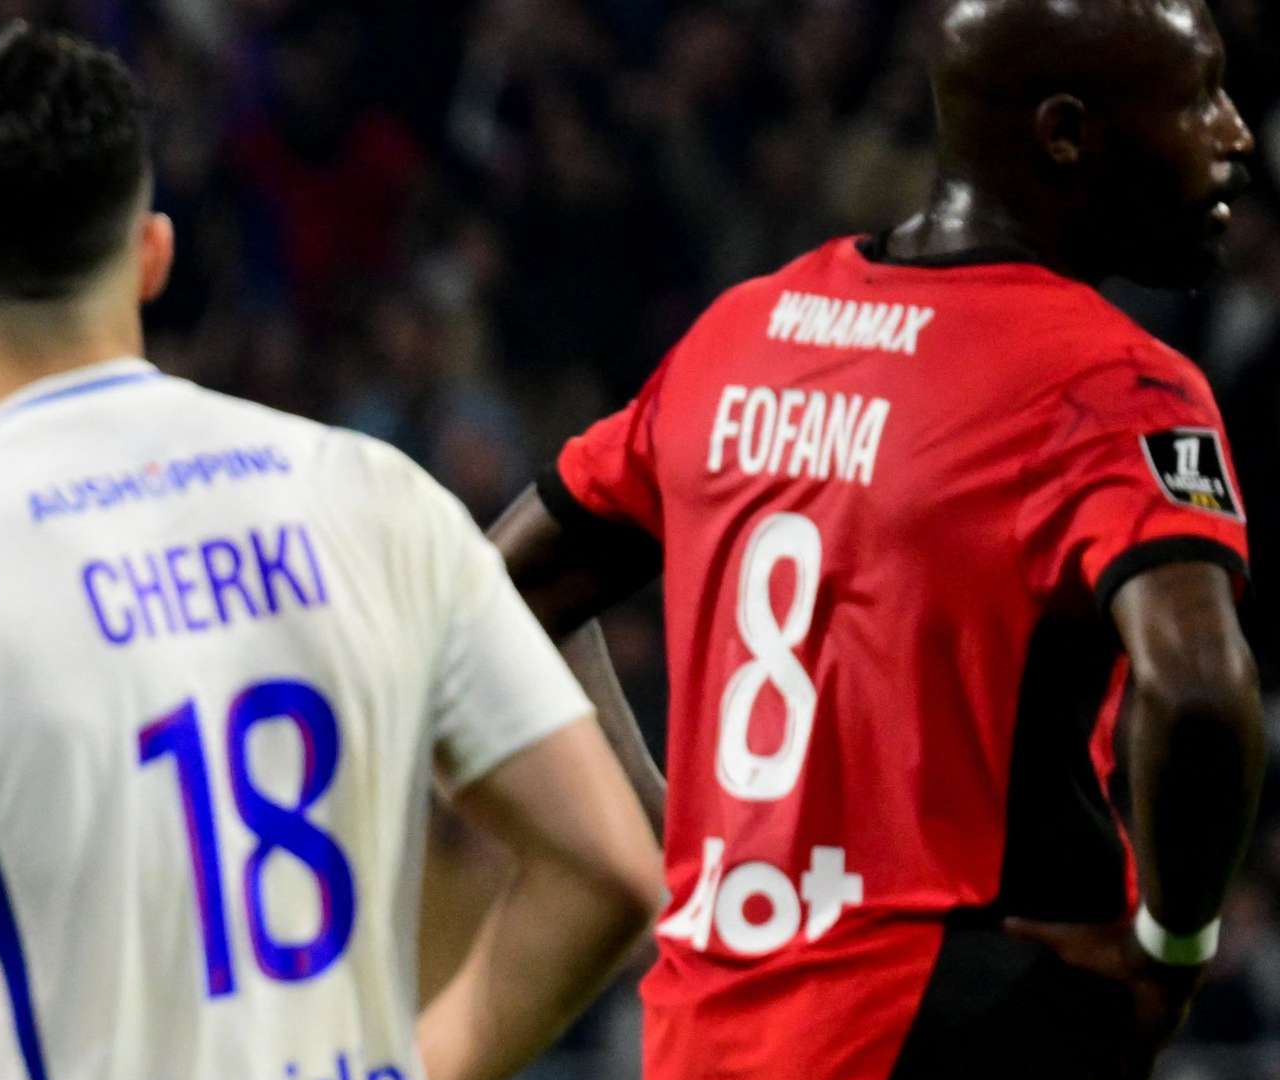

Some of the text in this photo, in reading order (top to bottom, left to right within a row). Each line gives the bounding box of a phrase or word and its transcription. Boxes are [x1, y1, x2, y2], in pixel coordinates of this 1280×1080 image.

[767, 290, 935, 356] WINAMAX
[707, 384, 891, 487] FOFANA
[81, 523, 328, 645] CHERKI
[715, 511, 822, 801] 8
[137, 678, 357, 998] 18
